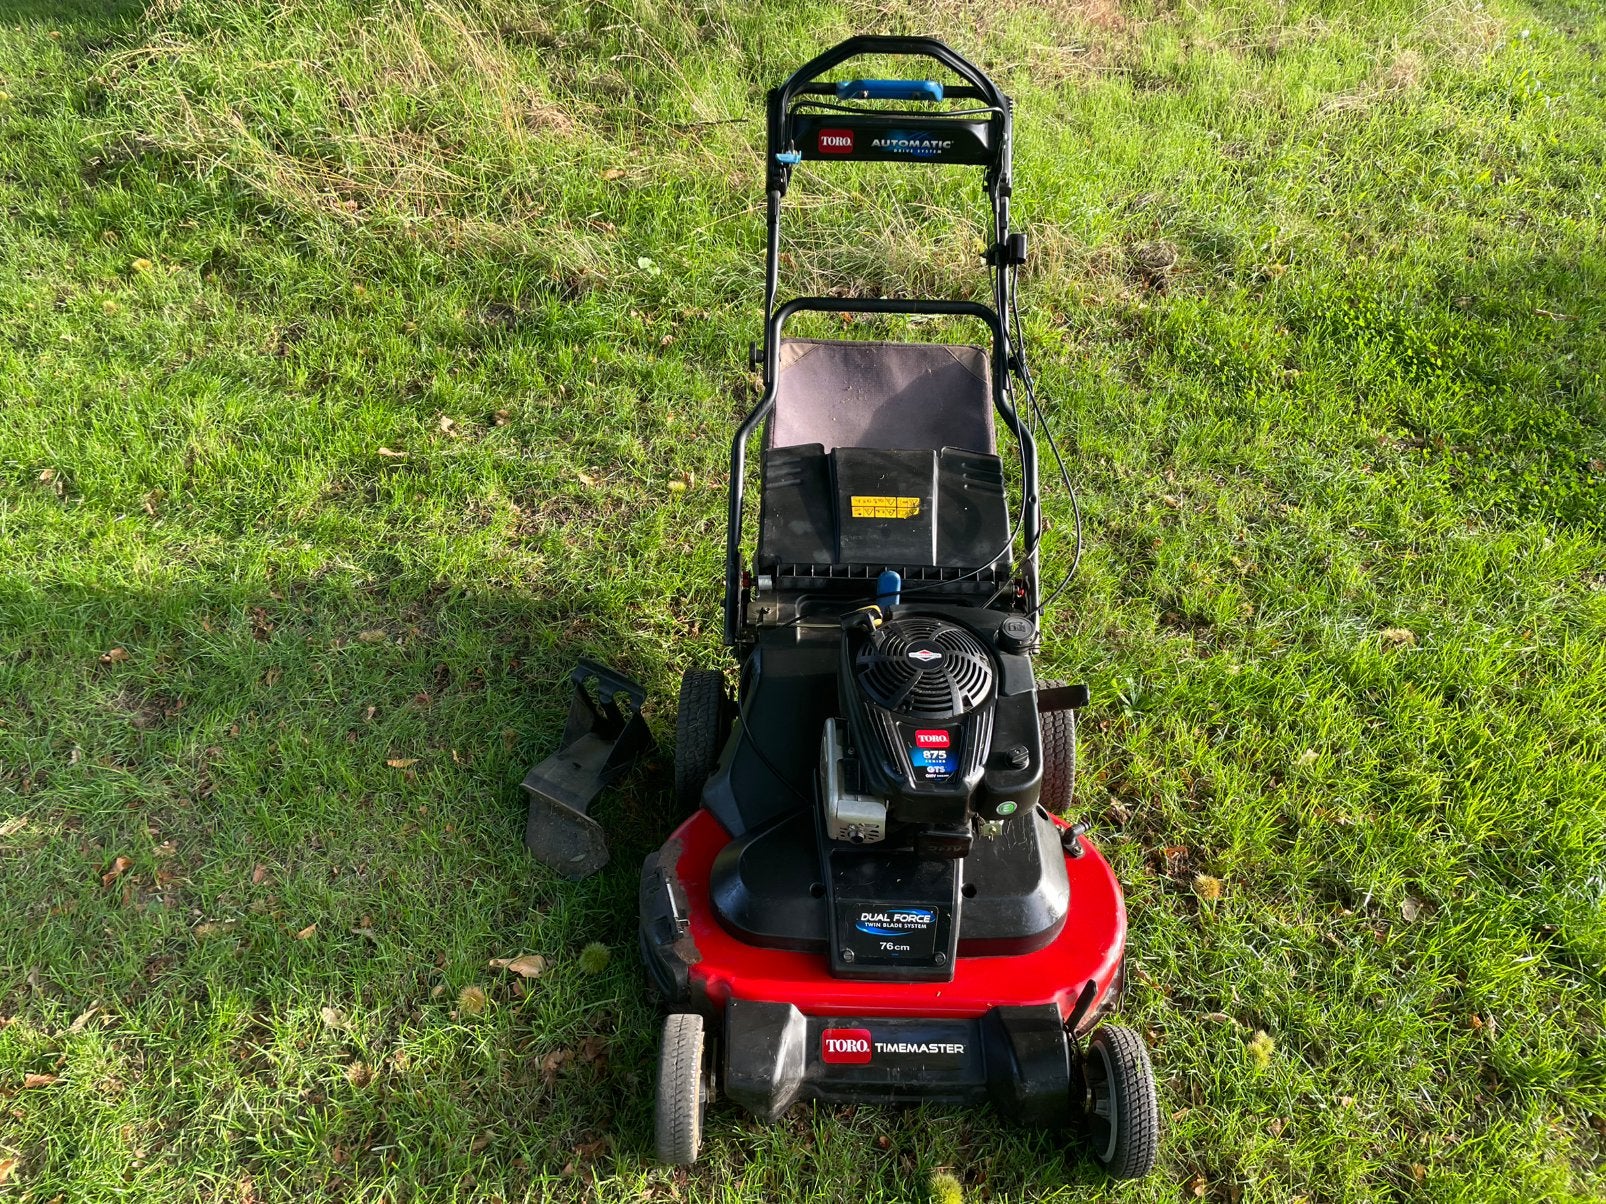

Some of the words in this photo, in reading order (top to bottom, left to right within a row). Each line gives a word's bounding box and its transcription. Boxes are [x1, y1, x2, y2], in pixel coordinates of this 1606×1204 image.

[871, 139, 952, 149] AUTOMATIC
[923, 750, 947, 759] 875
[860, 913, 890, 922] DUAL
[893, 914, 931, 923] FORCE
[875, 1043, 964, 1053] TIMEMASTER
